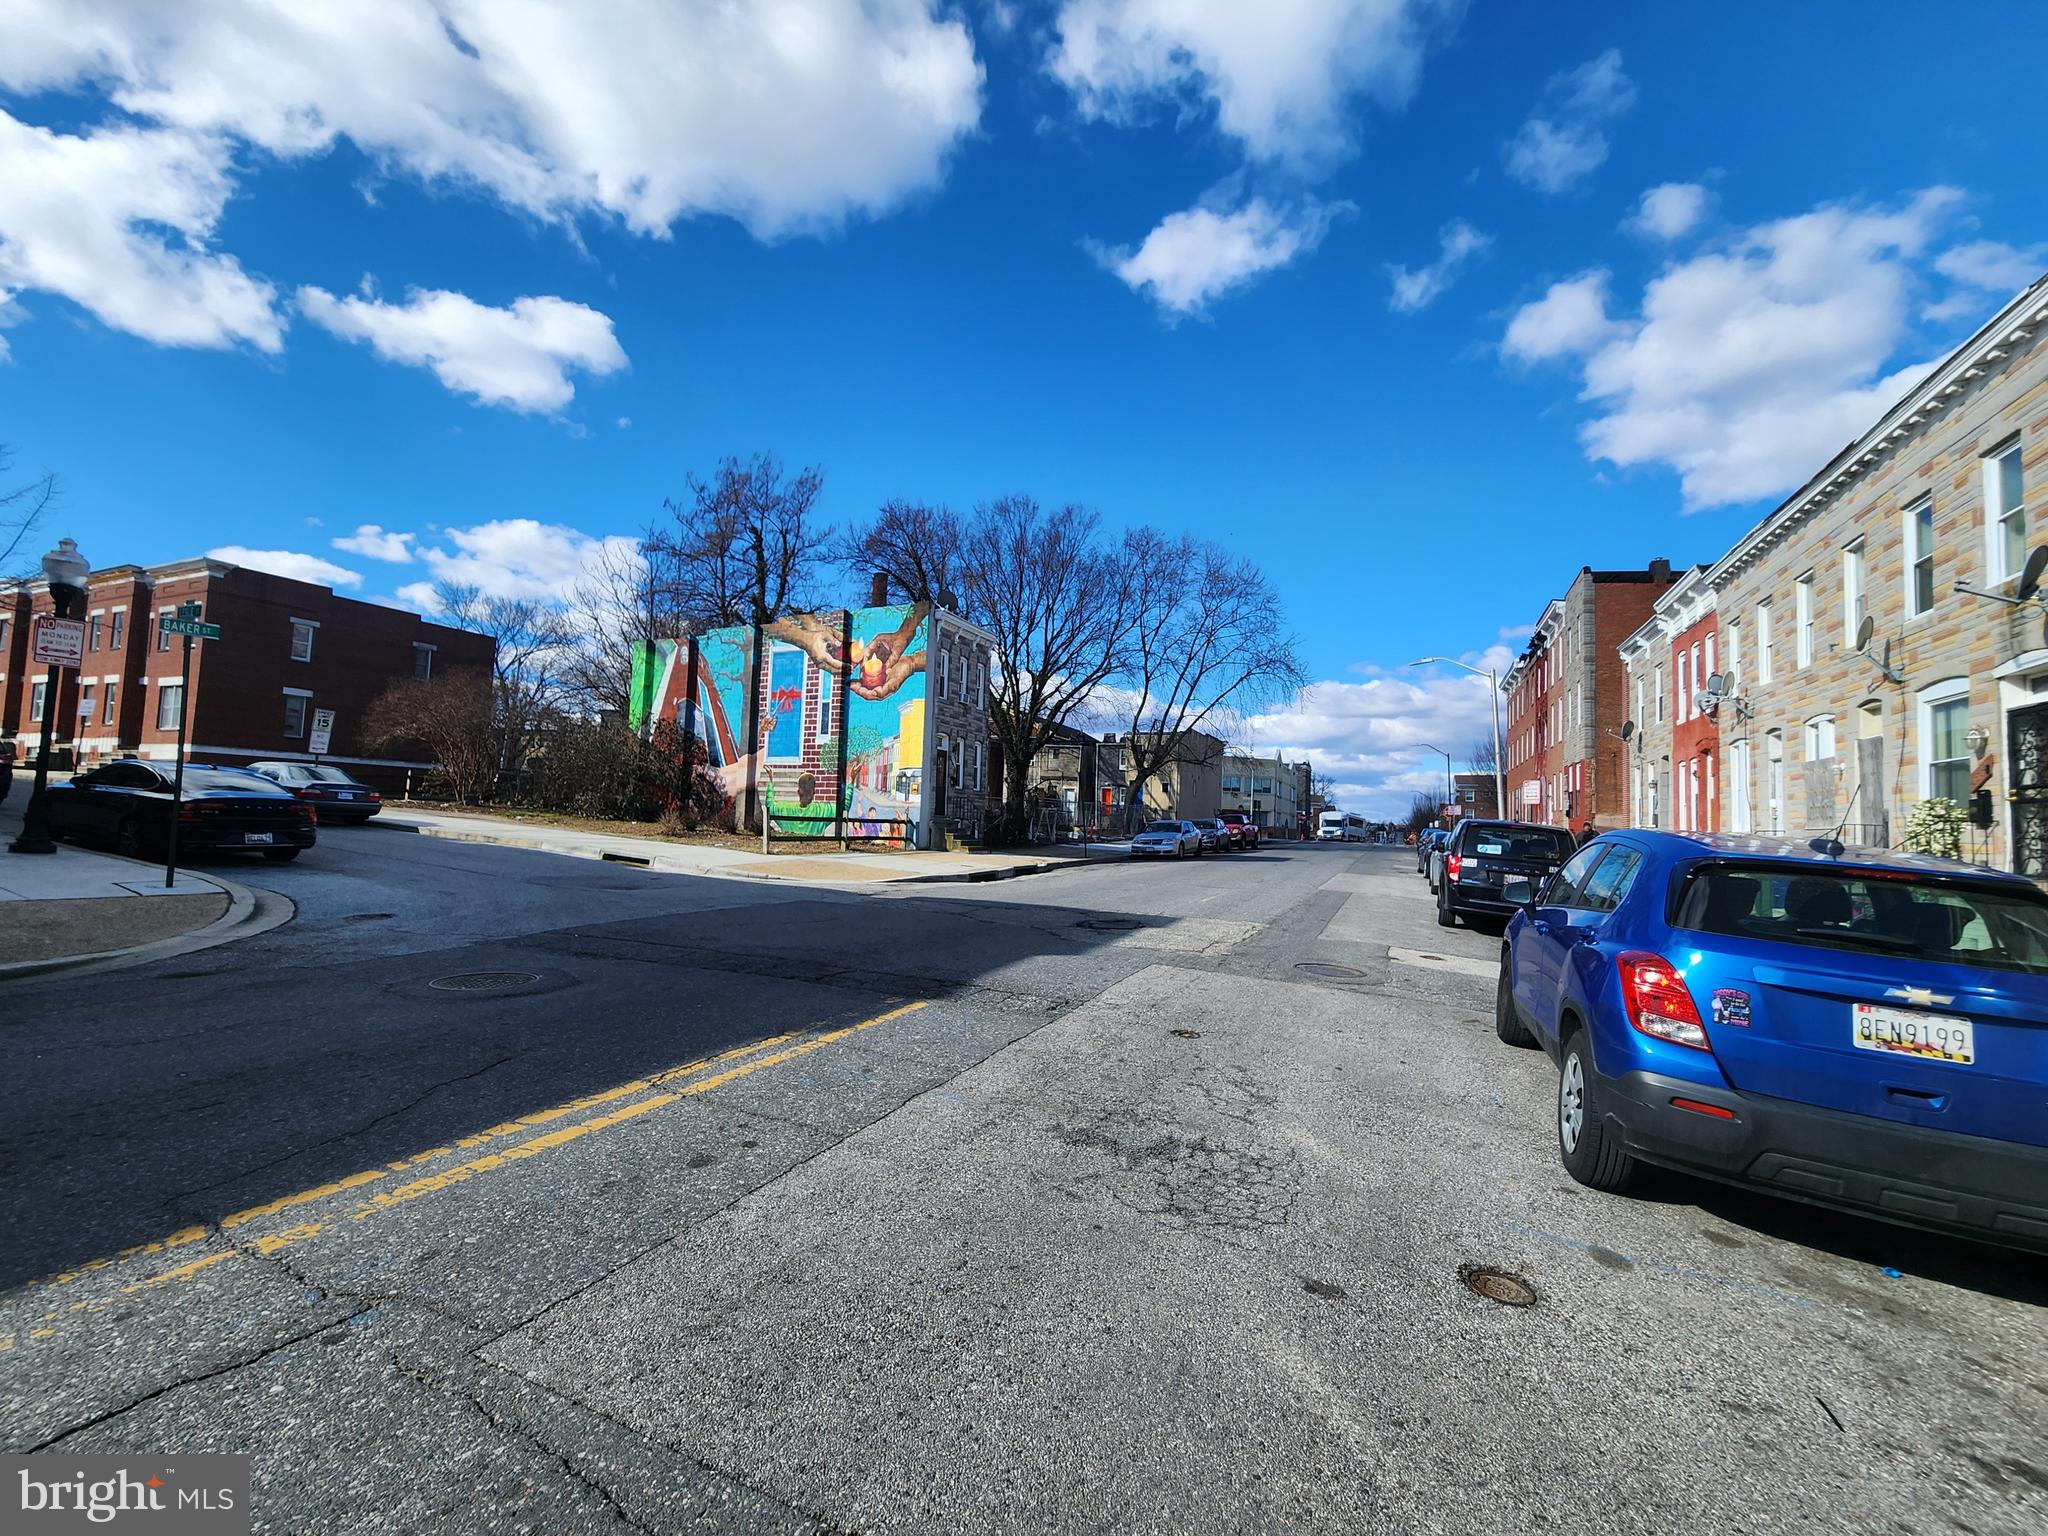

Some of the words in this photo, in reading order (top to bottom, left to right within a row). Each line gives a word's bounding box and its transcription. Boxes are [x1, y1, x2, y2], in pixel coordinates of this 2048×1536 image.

[40, 617, 55, 628] NO
[163, 619, 200, 634] BAKER
[41, 631, 79, 641] MONDAY
[317, 718, 330, 728] 15
[1860, 1017, 1965, 1052] 8EN9199
